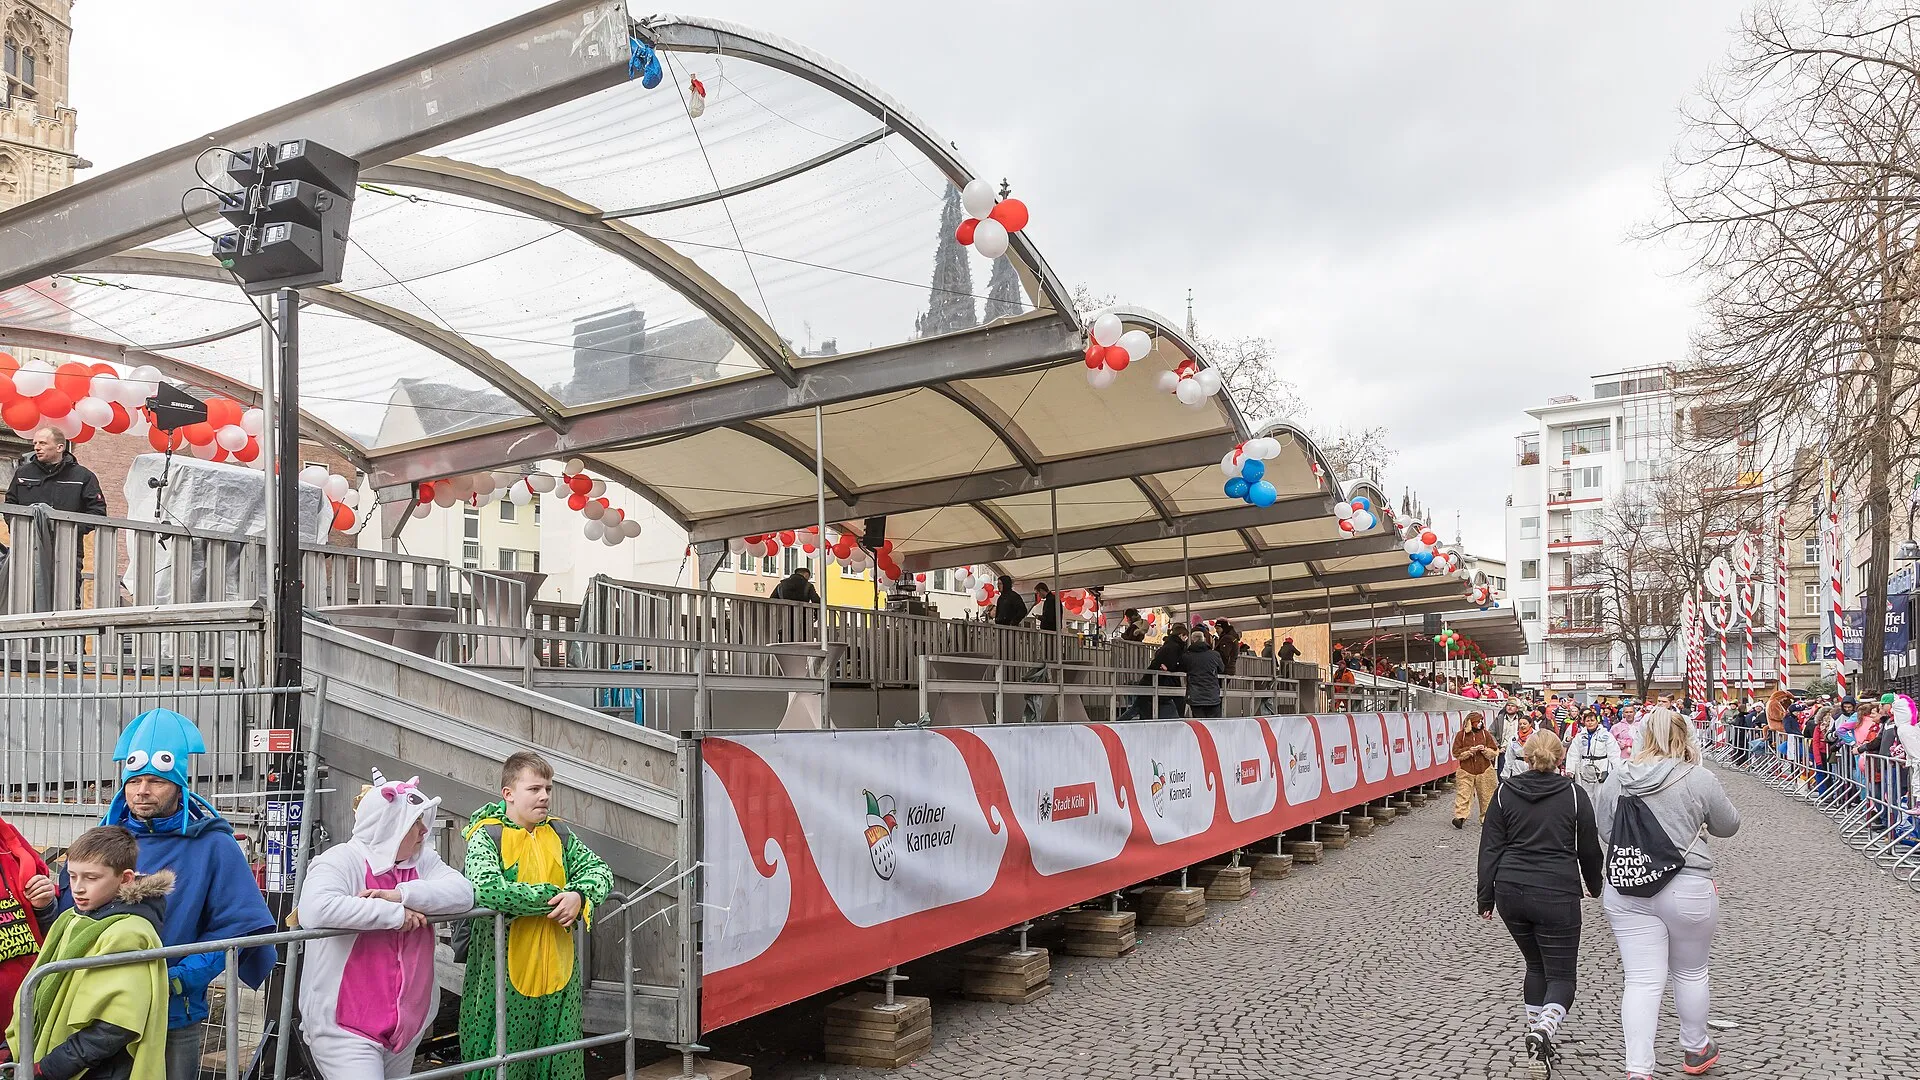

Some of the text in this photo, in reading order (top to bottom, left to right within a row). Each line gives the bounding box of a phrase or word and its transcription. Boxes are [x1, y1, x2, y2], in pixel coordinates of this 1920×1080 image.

[170, 401, 194, 409] SHURE
[1885, 612, 1906, 626] ffel
[1884, 625, 1899, 633] lsch
[1169, 769, 1187, 784] Kölner
[1169, 784, 1192, 801] Karneval
[1053, 794, 1085, 811] Stadt Köln
[906, 802, 946, 827] Kölner
[906, 823, 957, 853] Karneval
[1609, 854, 1653, 866] Londn
[1610, 863, 1677, 887] Ehrenf
